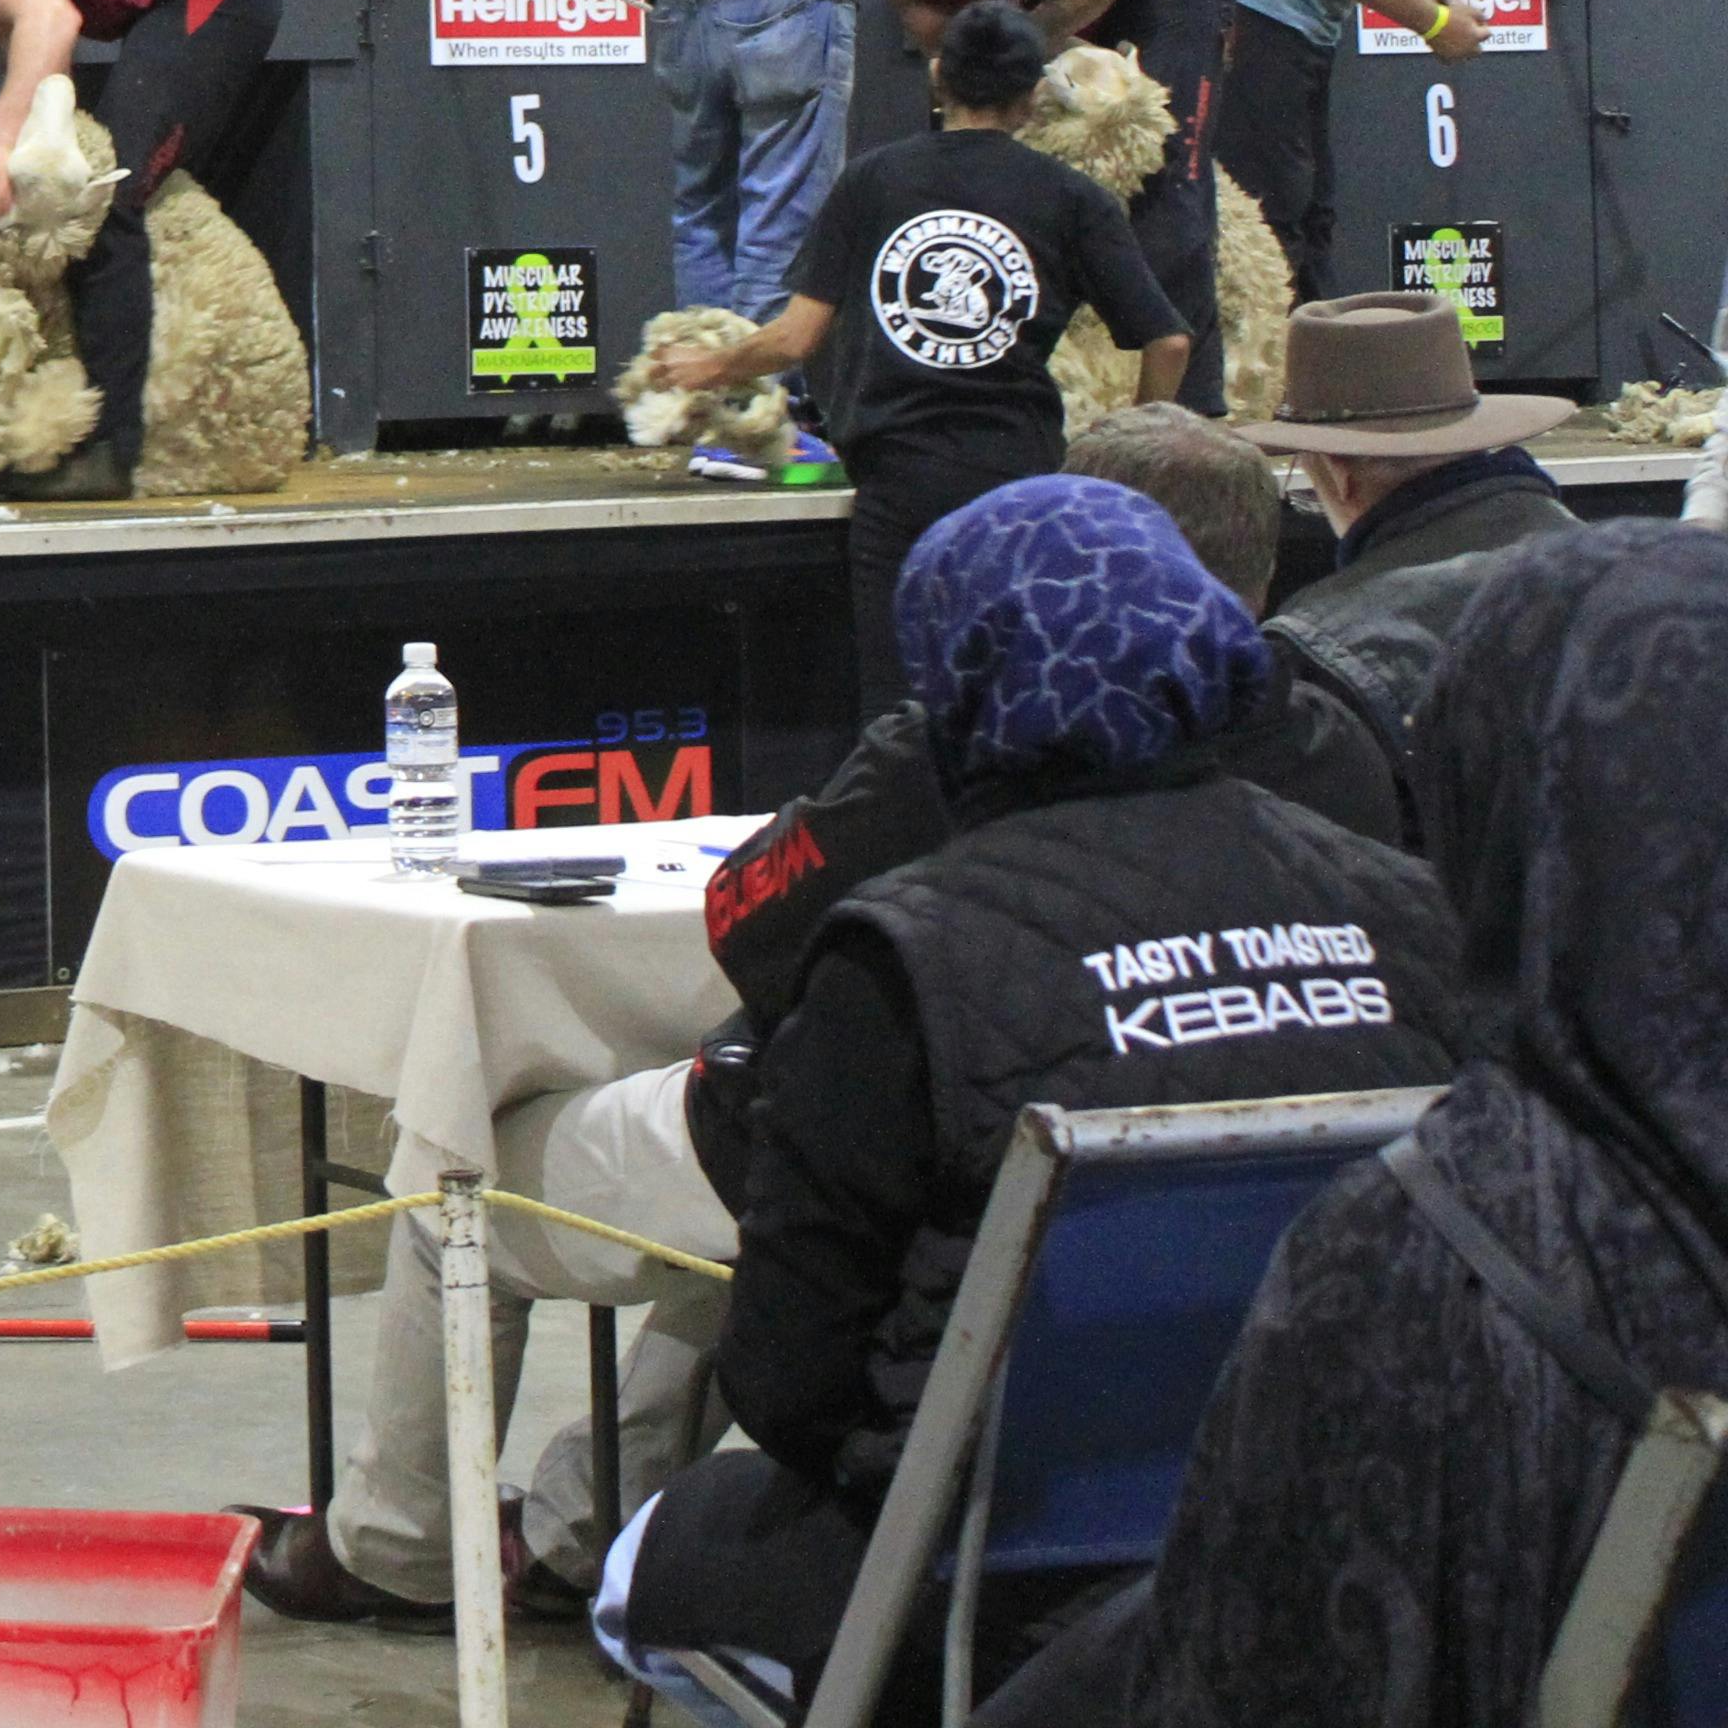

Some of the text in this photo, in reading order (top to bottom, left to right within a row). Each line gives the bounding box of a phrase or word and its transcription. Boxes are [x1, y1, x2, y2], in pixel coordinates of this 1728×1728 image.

[448, 42, 630, 60] When results matter
[1373, 31, 1419, 48] When
[510, 93, 546, 184] 5
[1425, 83, 1458, 168] 6
[881, 216, 1039, 301] WARRNAMBOOL
[1403, 238, 1492, 261] MUSCULAR
[482, 263, 584, 288] MUSCULAR
[1402, 262, 1493, 286] DYSTROPHY
[482, 289, 585, 314] DYSTROPHY
[479, 315, 589, 341] AWARENESS
[596, 706, 709, 744] 95.3
[102, 745, 713, 854] COAST FM
[1082, 923, 1376, 992] TASTY TOASTED
[1104, 977, 1394, 1055] KEBABS
